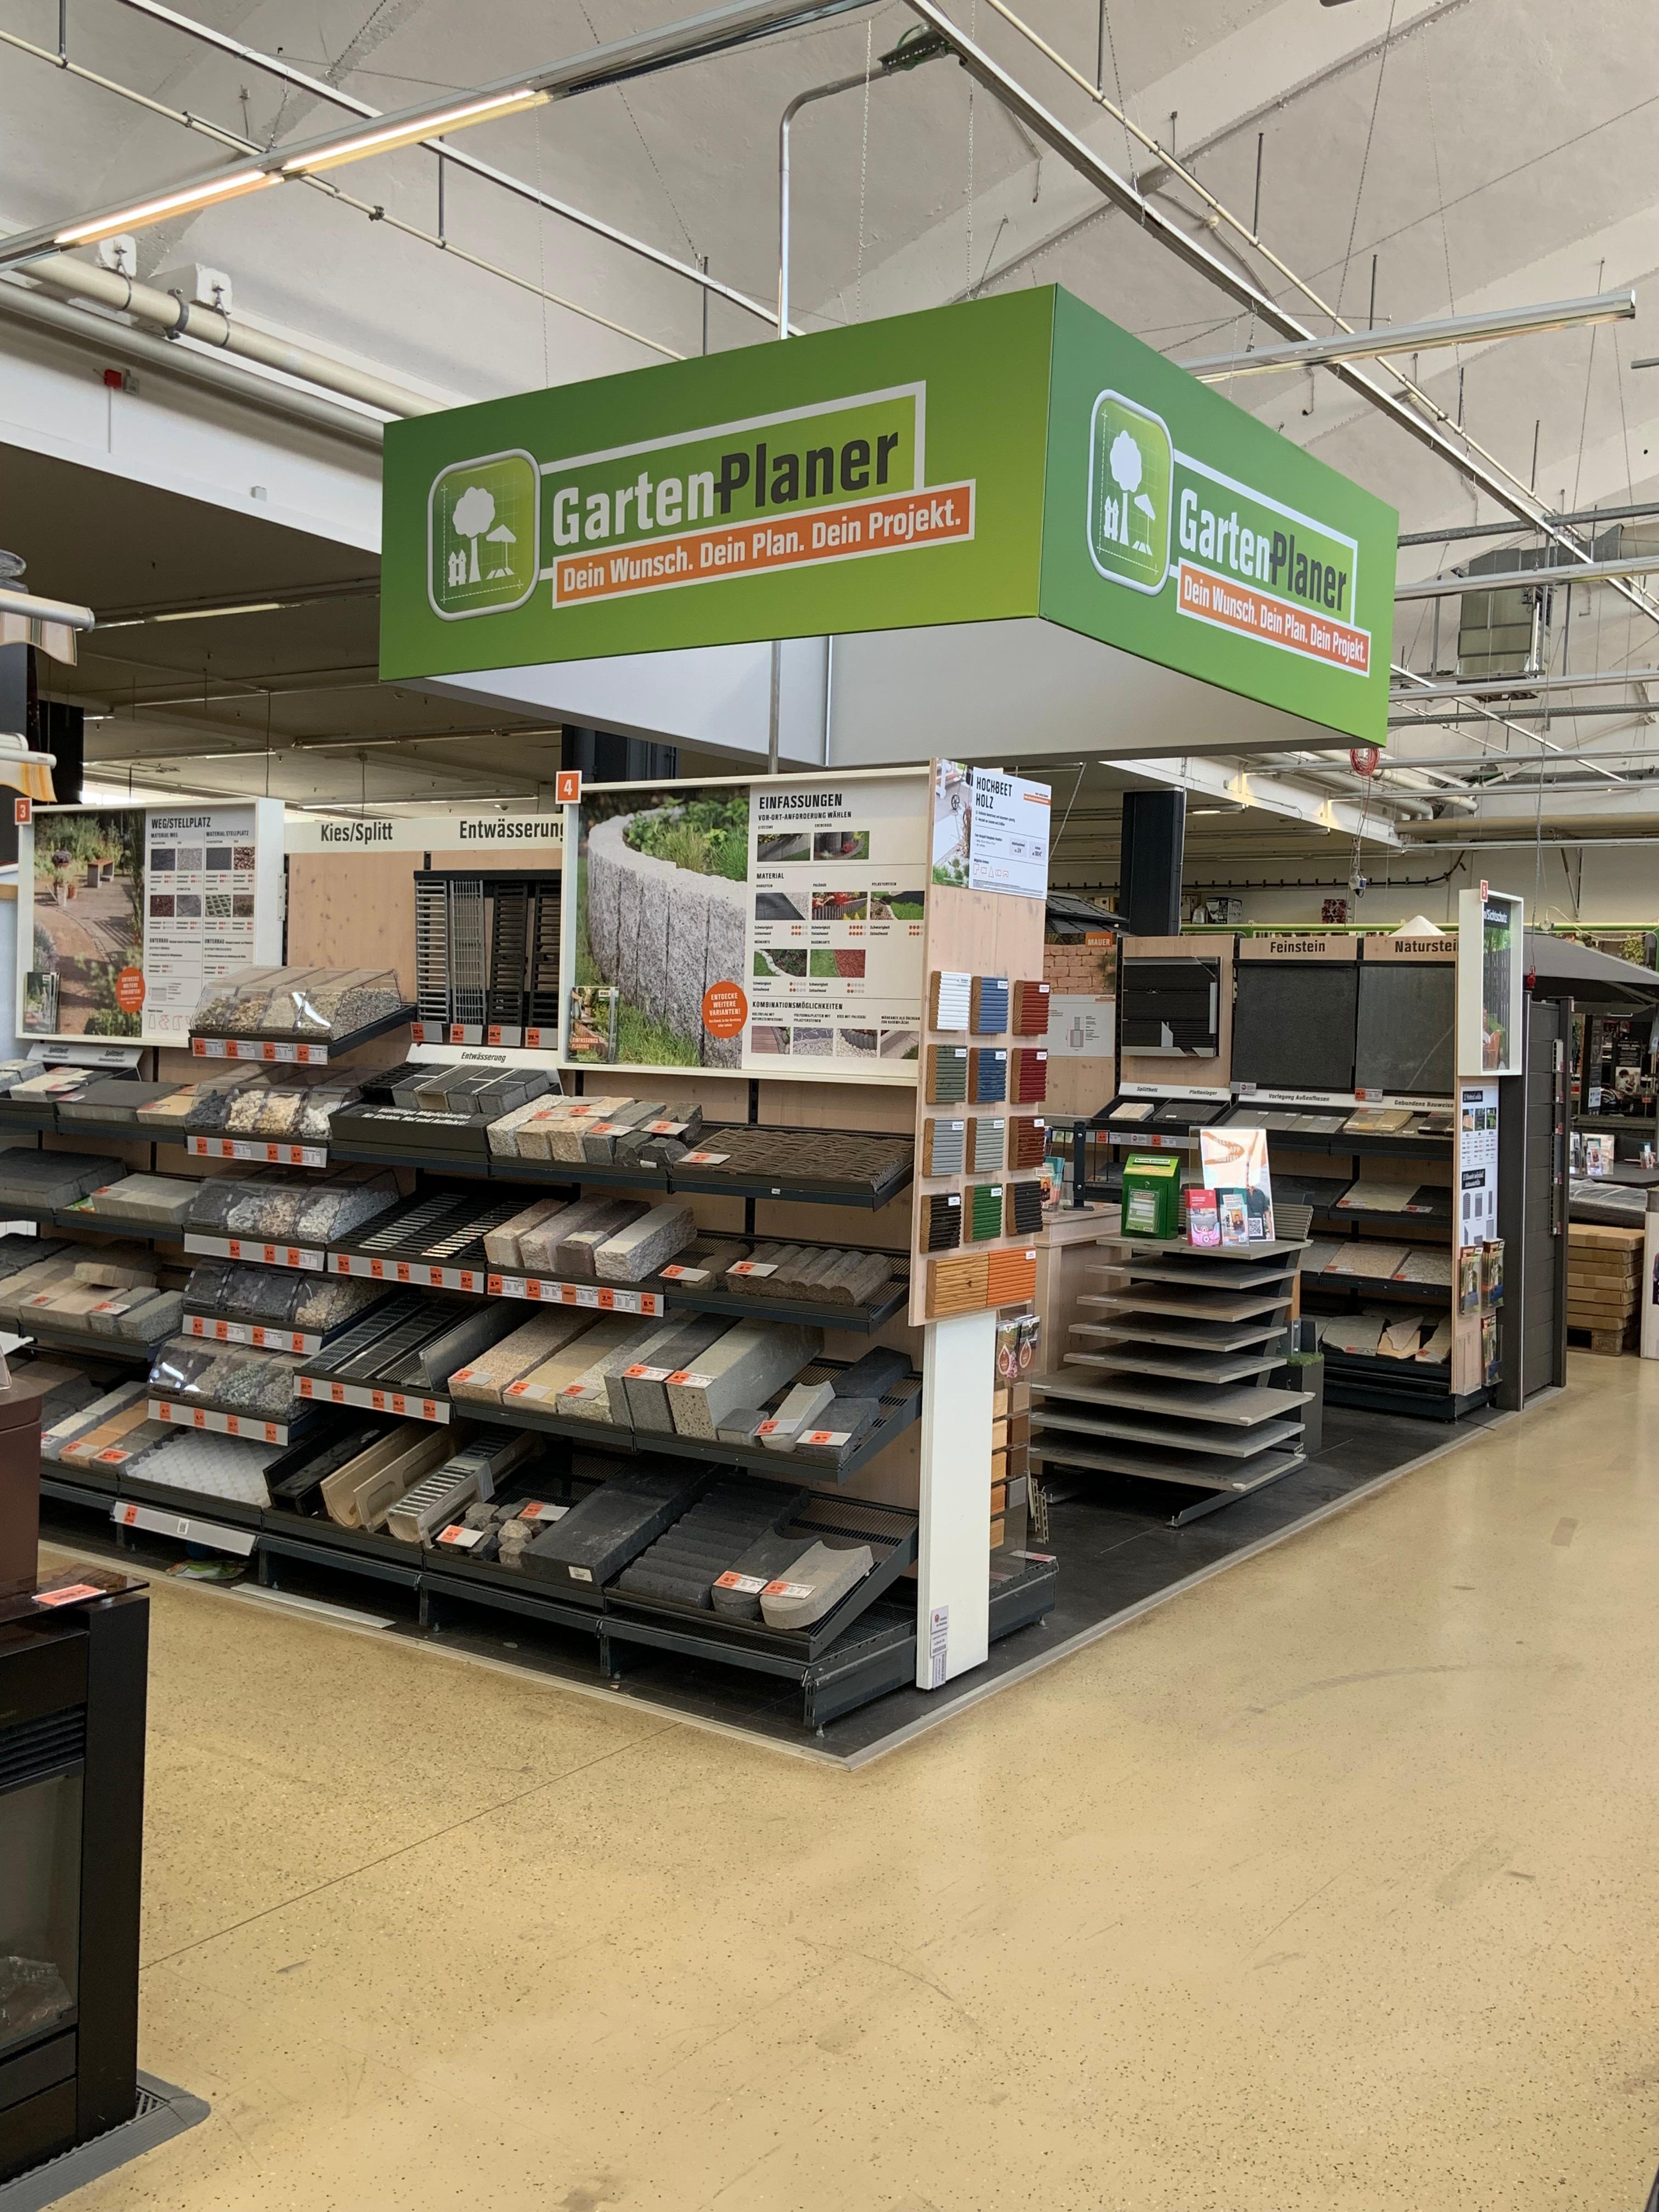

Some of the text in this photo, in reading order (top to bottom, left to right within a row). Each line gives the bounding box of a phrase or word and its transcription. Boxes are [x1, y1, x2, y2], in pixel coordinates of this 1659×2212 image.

[552, 432, 898, 547] GartenPlaner
[564, 499, 961, 593] Dein Wunsch. Dein Plan. Dein Projekt.
[1180, 489, 1346, 611] GartenPlaner
[1184, 574, 1365, 663] Dein Wunsch. Dein Plan. Dein Projekt.
[564, 779, 572, 795] 4
[977, 776, 1012, 797] HOCHBEET
[759, 794, 842, 809] EINFASSUNGEN
[976, 793, 994, 809] HOLZ
[20, 804, 26, 818] 3
[758, 812, 826, 821] VOR-ORT-ANFORDERUNG
[151, 817, 211, 829] WEG/STELLPLATZ
[321, 822, 393, 844] Kies/Splitt
[1483, 885, 1486, 897] 5
[1270, 940, 1325, 953] Feinstein
[1395, 939, 1459, 952] Naturstei
[752, 1002, 843, 1010] KOMBINATIONSMÖGLICHKEITEN
[461, 1052, 506, 1062] Entwässerung
